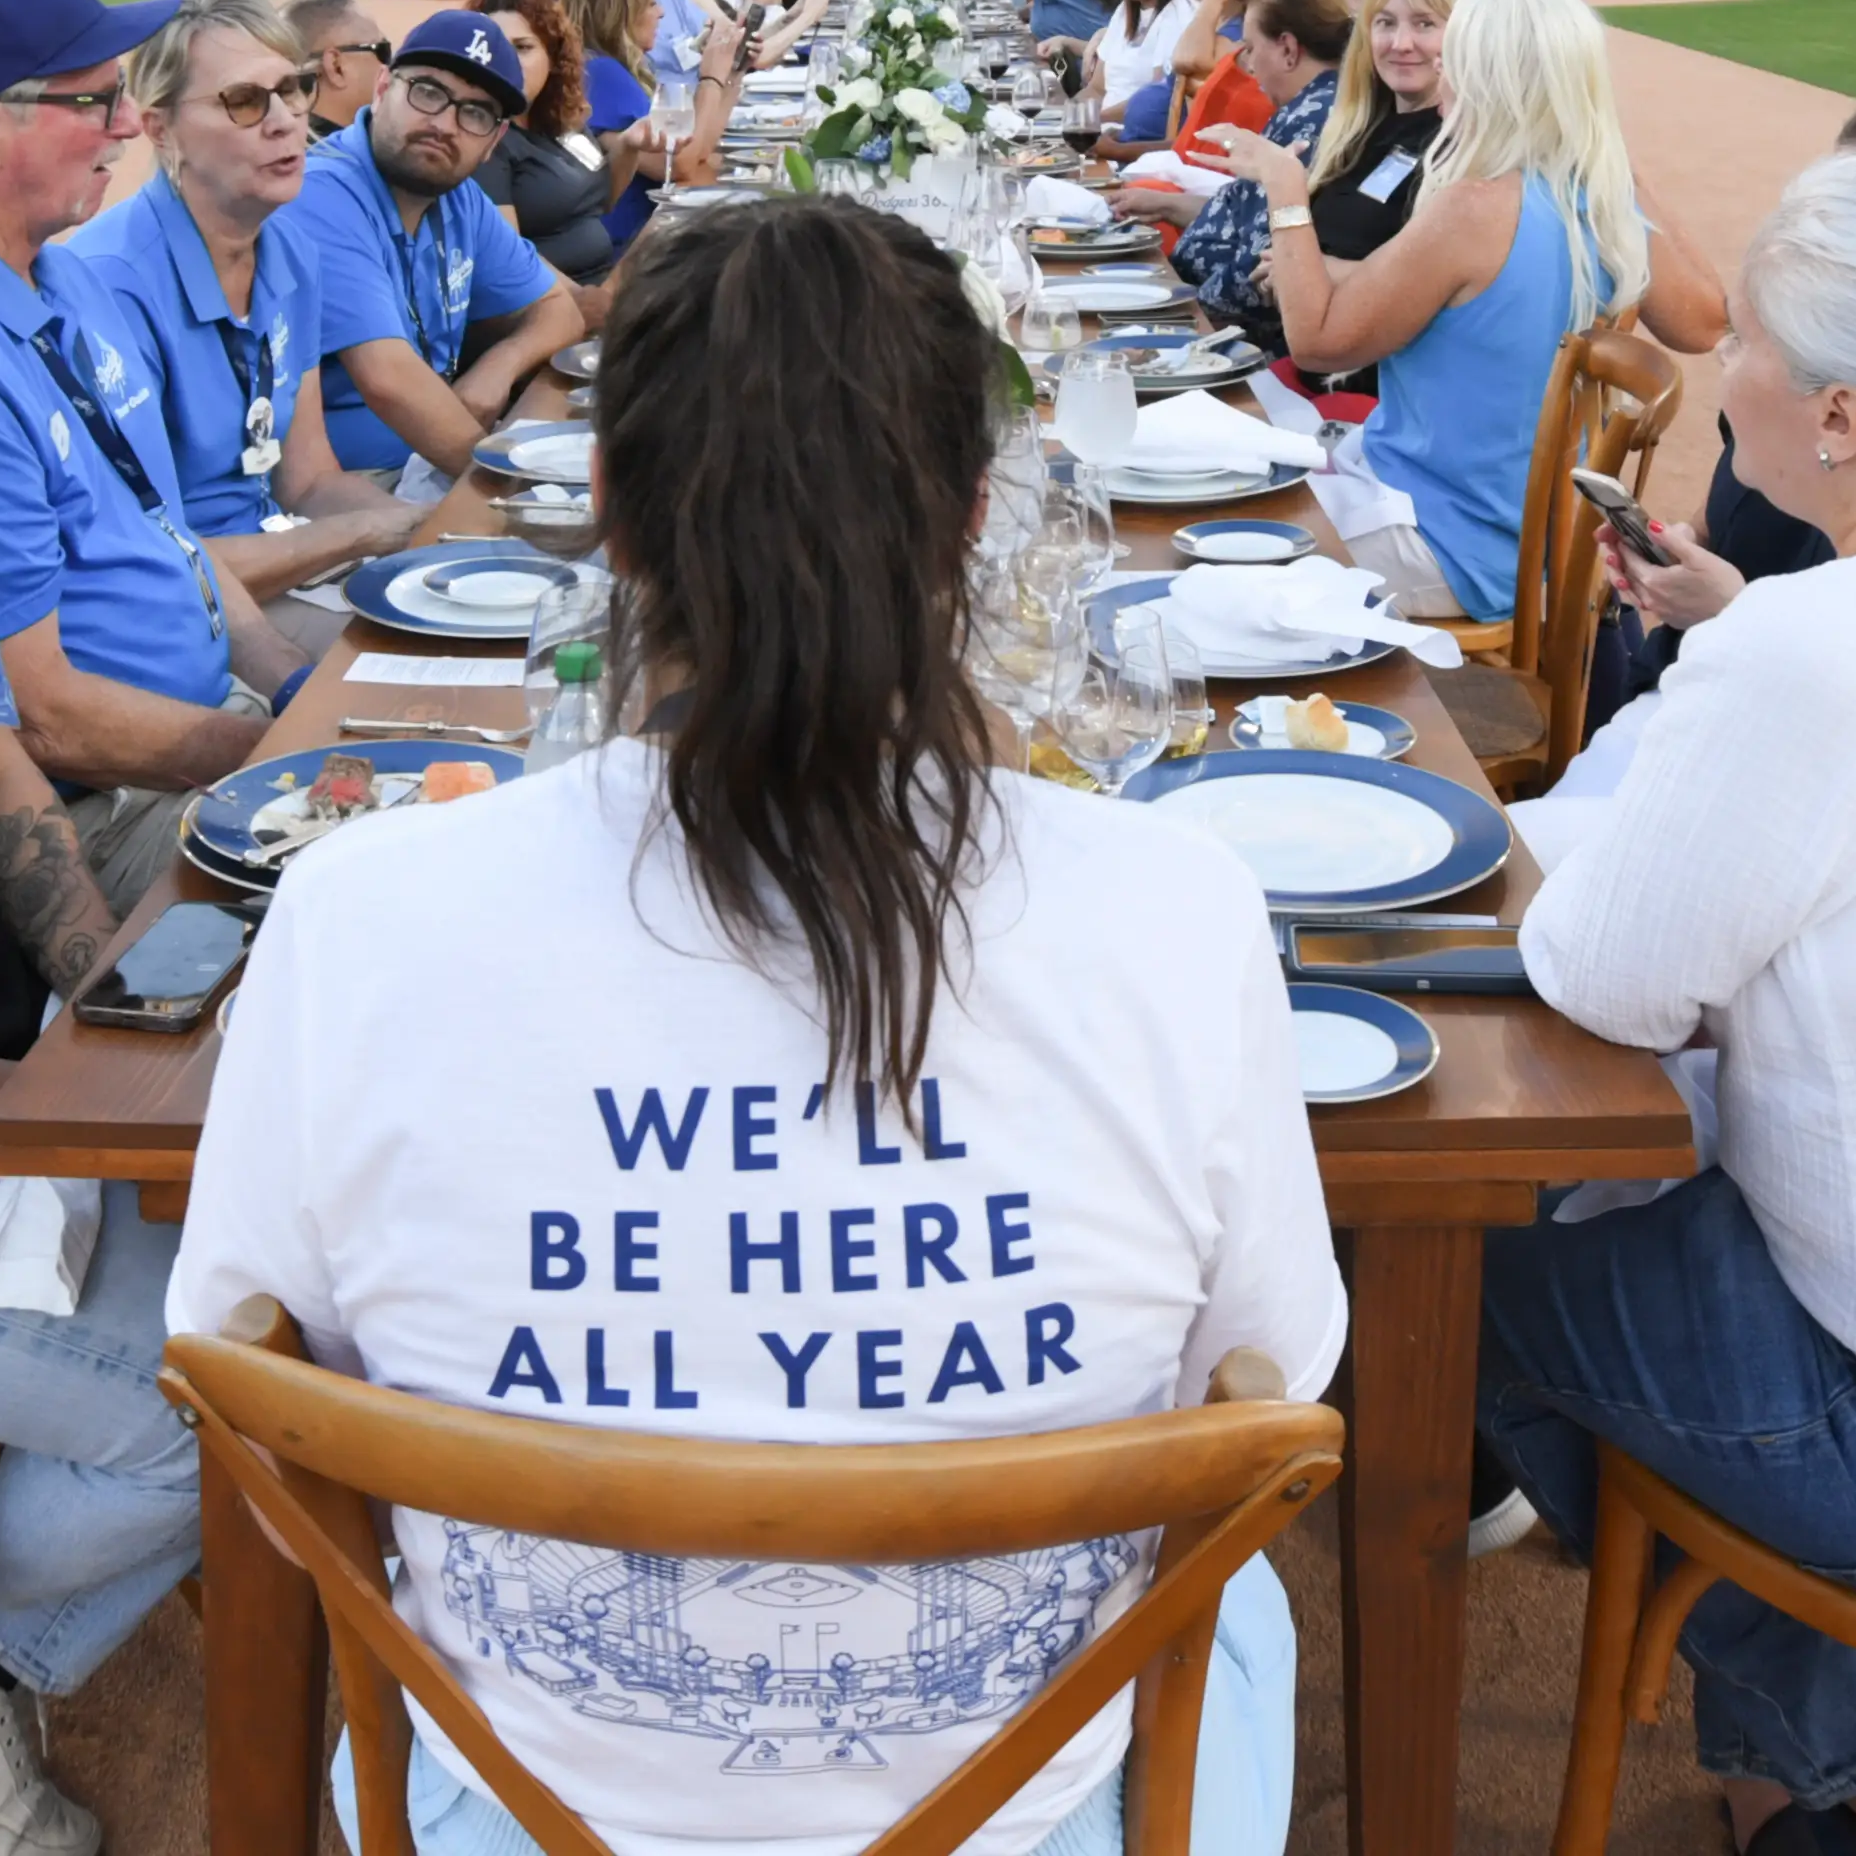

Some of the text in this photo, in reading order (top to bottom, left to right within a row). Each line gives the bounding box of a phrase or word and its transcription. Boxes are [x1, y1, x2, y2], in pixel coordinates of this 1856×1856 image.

[464, 28, 493, 66] LA
[530, 1191, 1036, 1294] BE HERE
[487, 1301, 1082, 1411] ALL YEAR
